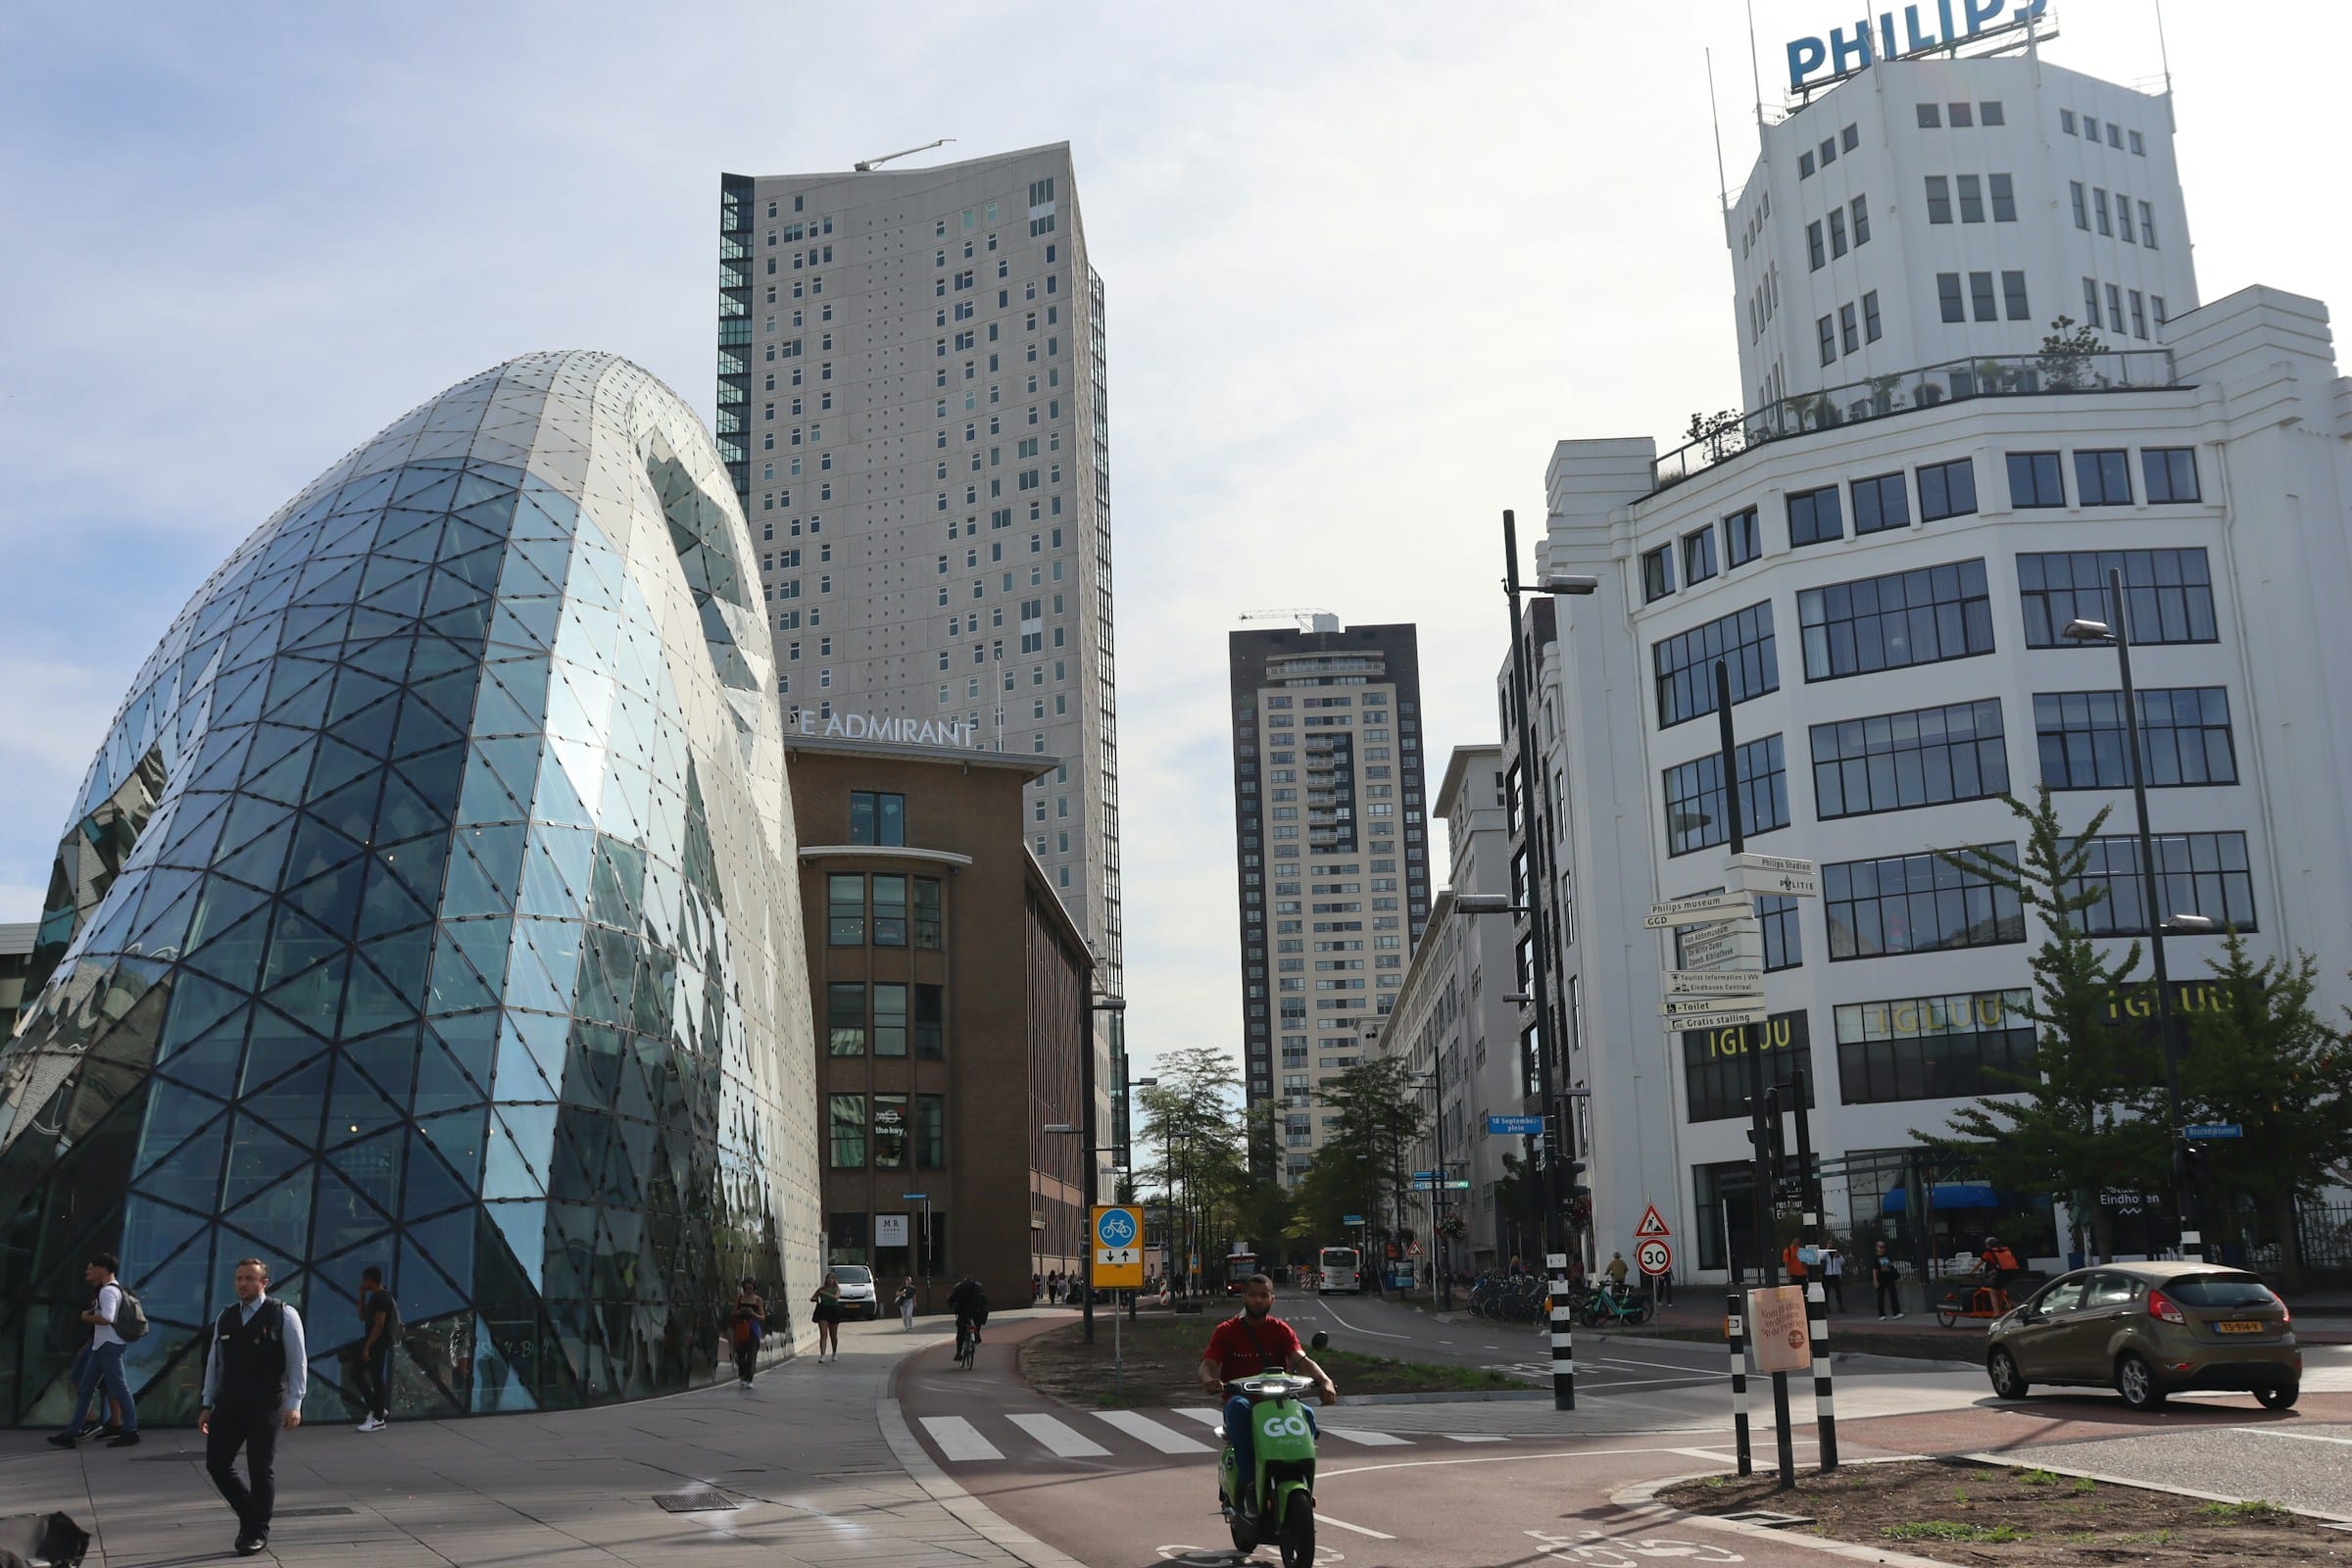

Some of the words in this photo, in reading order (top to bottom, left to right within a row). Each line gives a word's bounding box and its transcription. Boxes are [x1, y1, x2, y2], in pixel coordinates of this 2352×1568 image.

[825, 711, 977, 748] ADMIRANT
[1761, 858, 1784, 869] Philips
[1785, 861, 1811, 871] Stadion
[1652, 902, 1682, 913] Philips
[1684, 897, 1721, 909] museum
[1647, 916, 1668, 926] GGD
[1685, 934, 1694, 944] Van
[1694, 925, 1729, 941] Abbemuseum
[1688, 948, 1694, 956] De
[1695, 946, 1708, 955] Witte
[1708, 941, 1723, 951] Dame
[1689, 955, 1705, 966] Openb.
[1705, 947, 1734, 961] Bibliotheek
[1687, 1017, 1714, 1027] Gratis
[1716, 1014, 1750, 1025] stalling
[1876, 995, 2001, 1036] IGLUU
[889, 1127, 904, 1137] key
[2100, 1194, 2160, 1205] Eindhoen
[1643, 1250, 1667, 1265] 30
[1263, 1416, 1306, 1438] GO
